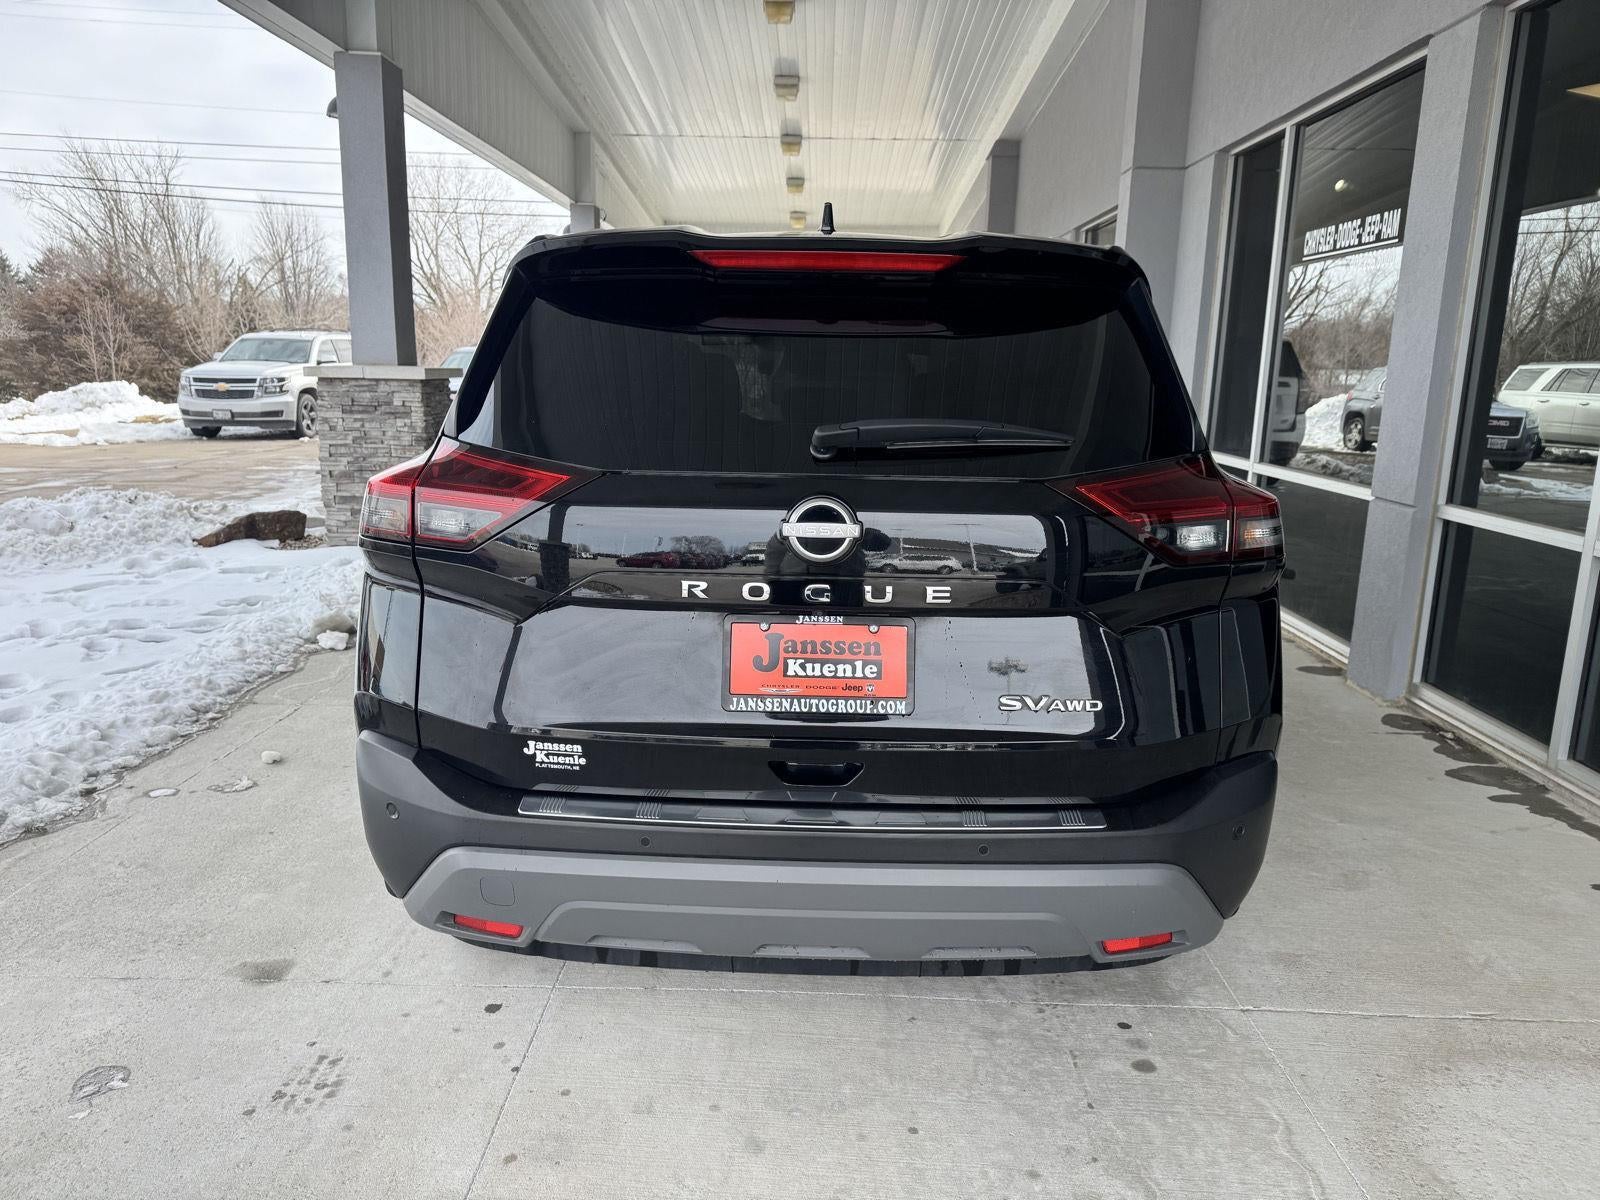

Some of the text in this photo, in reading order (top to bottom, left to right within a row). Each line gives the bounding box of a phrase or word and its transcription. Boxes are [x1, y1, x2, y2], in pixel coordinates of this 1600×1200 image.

[784, 525, 859, 536] NISSAN
[681, 580, 952, 604] ROGUE
[796, 615, 844, 624] JANSSEN
[752, 632, 882, 673] Janssen
[786, 659, 878, 678] Kuenle
[841, 683, 863, 693] Jeep
[729, 697, 906, 715] JANSSENAUTOGROUP.COM
[999, 695, 1103, 712] SV AWD
[523, 740, 582, 755] Janssen
[535, 750, 587, 765] Kuenle
